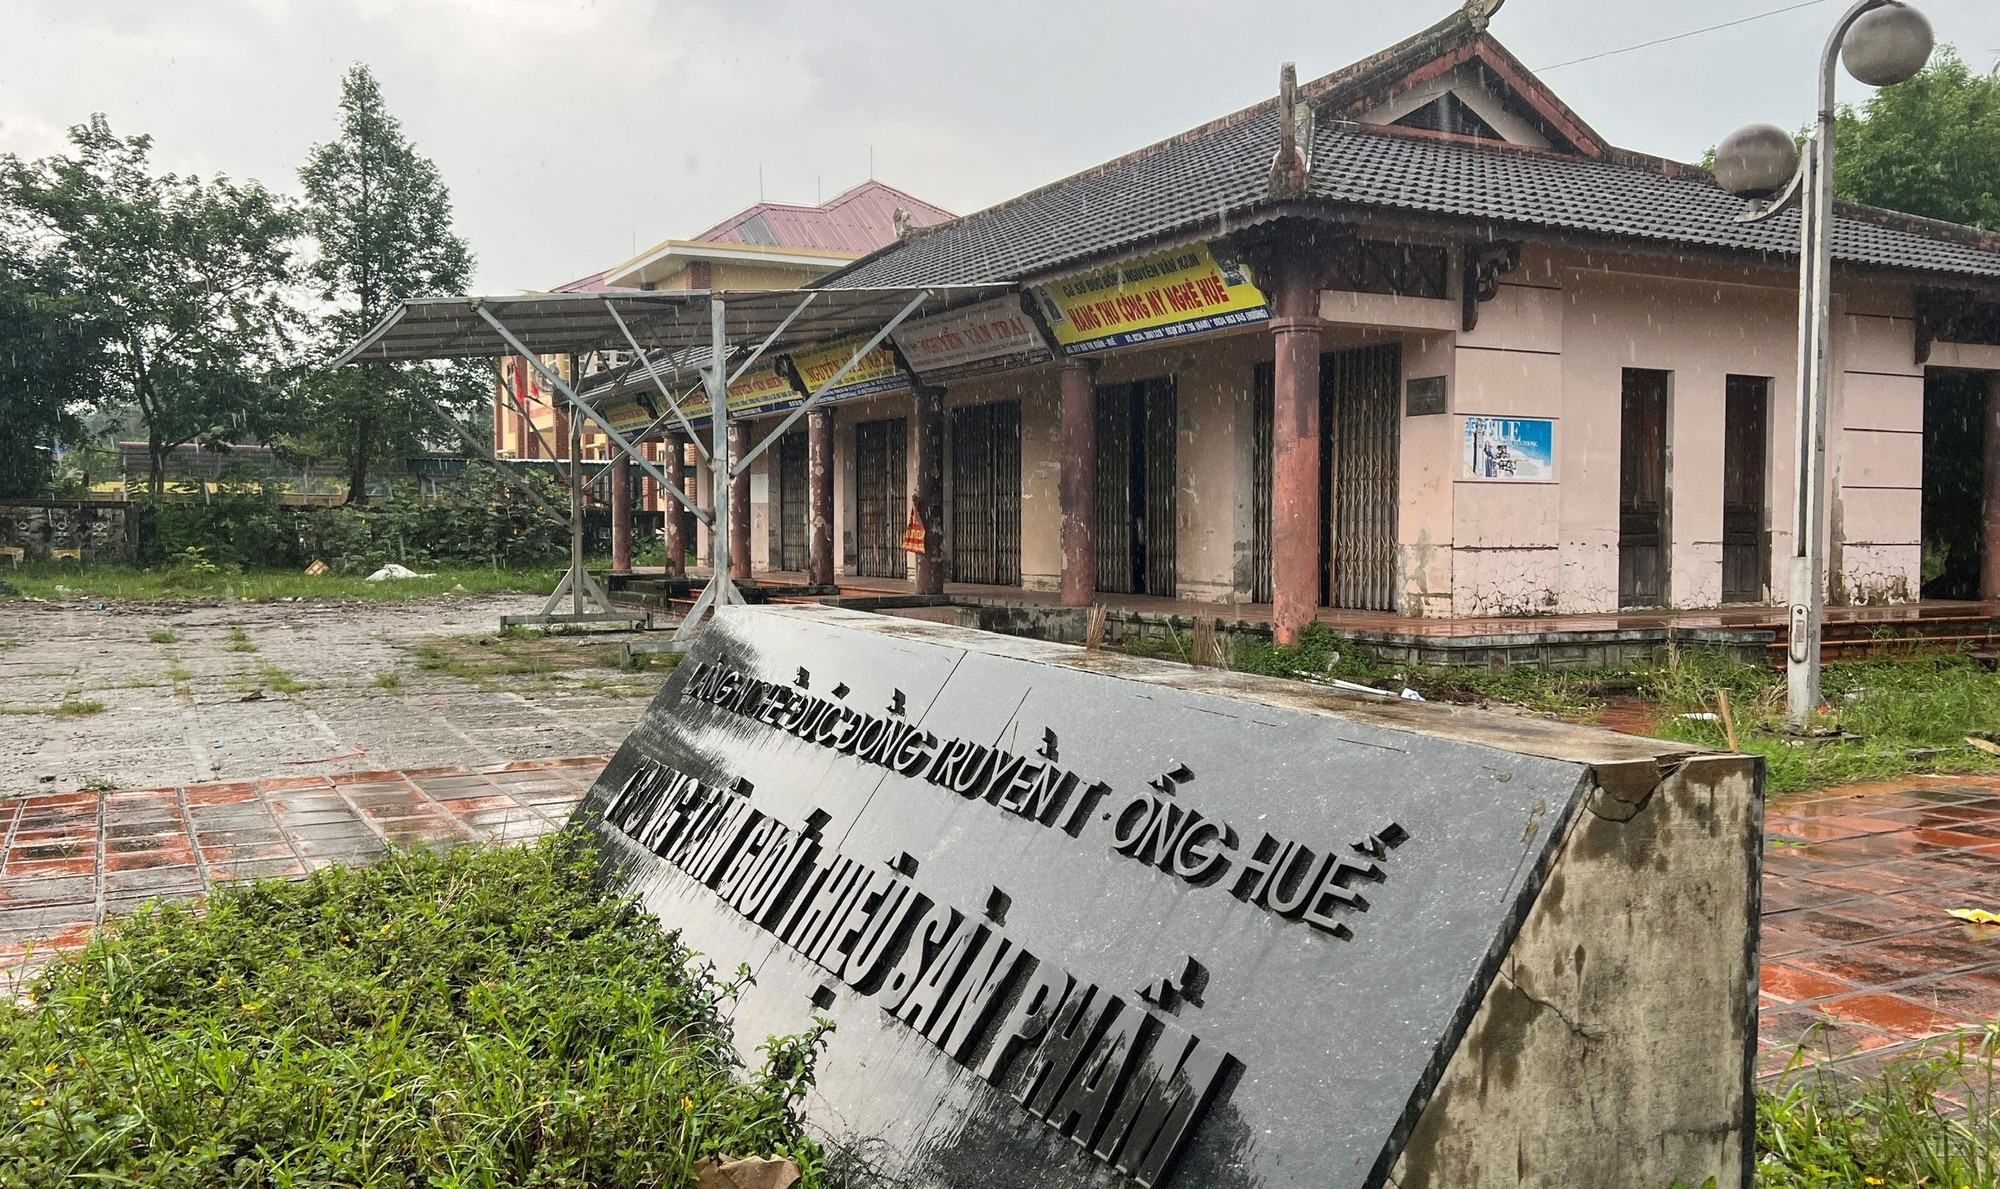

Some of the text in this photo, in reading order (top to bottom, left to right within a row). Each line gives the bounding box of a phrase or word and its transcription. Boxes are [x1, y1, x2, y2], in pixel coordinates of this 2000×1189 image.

[1067, 300, 1102, 333] HÀNG
[1096, 294, 1120, 326] THỦ
[1116, 291, 1149, 324] CÔNG
[1163, 277, 1204, 313] NGHỆ
[1198, 268, 1230, 306] HUẾ
[664, 776, 768, 892] TÂM
[715, 806, 838, 934] GIỚI
[833, 687, 938, 778] ĐỒNG
[923, 726, 1080, 829] TRUYỀN
[1228, 822, 1411, 942] HUẾ
[773, 843, 936, 1011] THIỆU
[878, 884, 1041, 1067] SẢN
[976, 953, 1247, 1188] PHẨM
